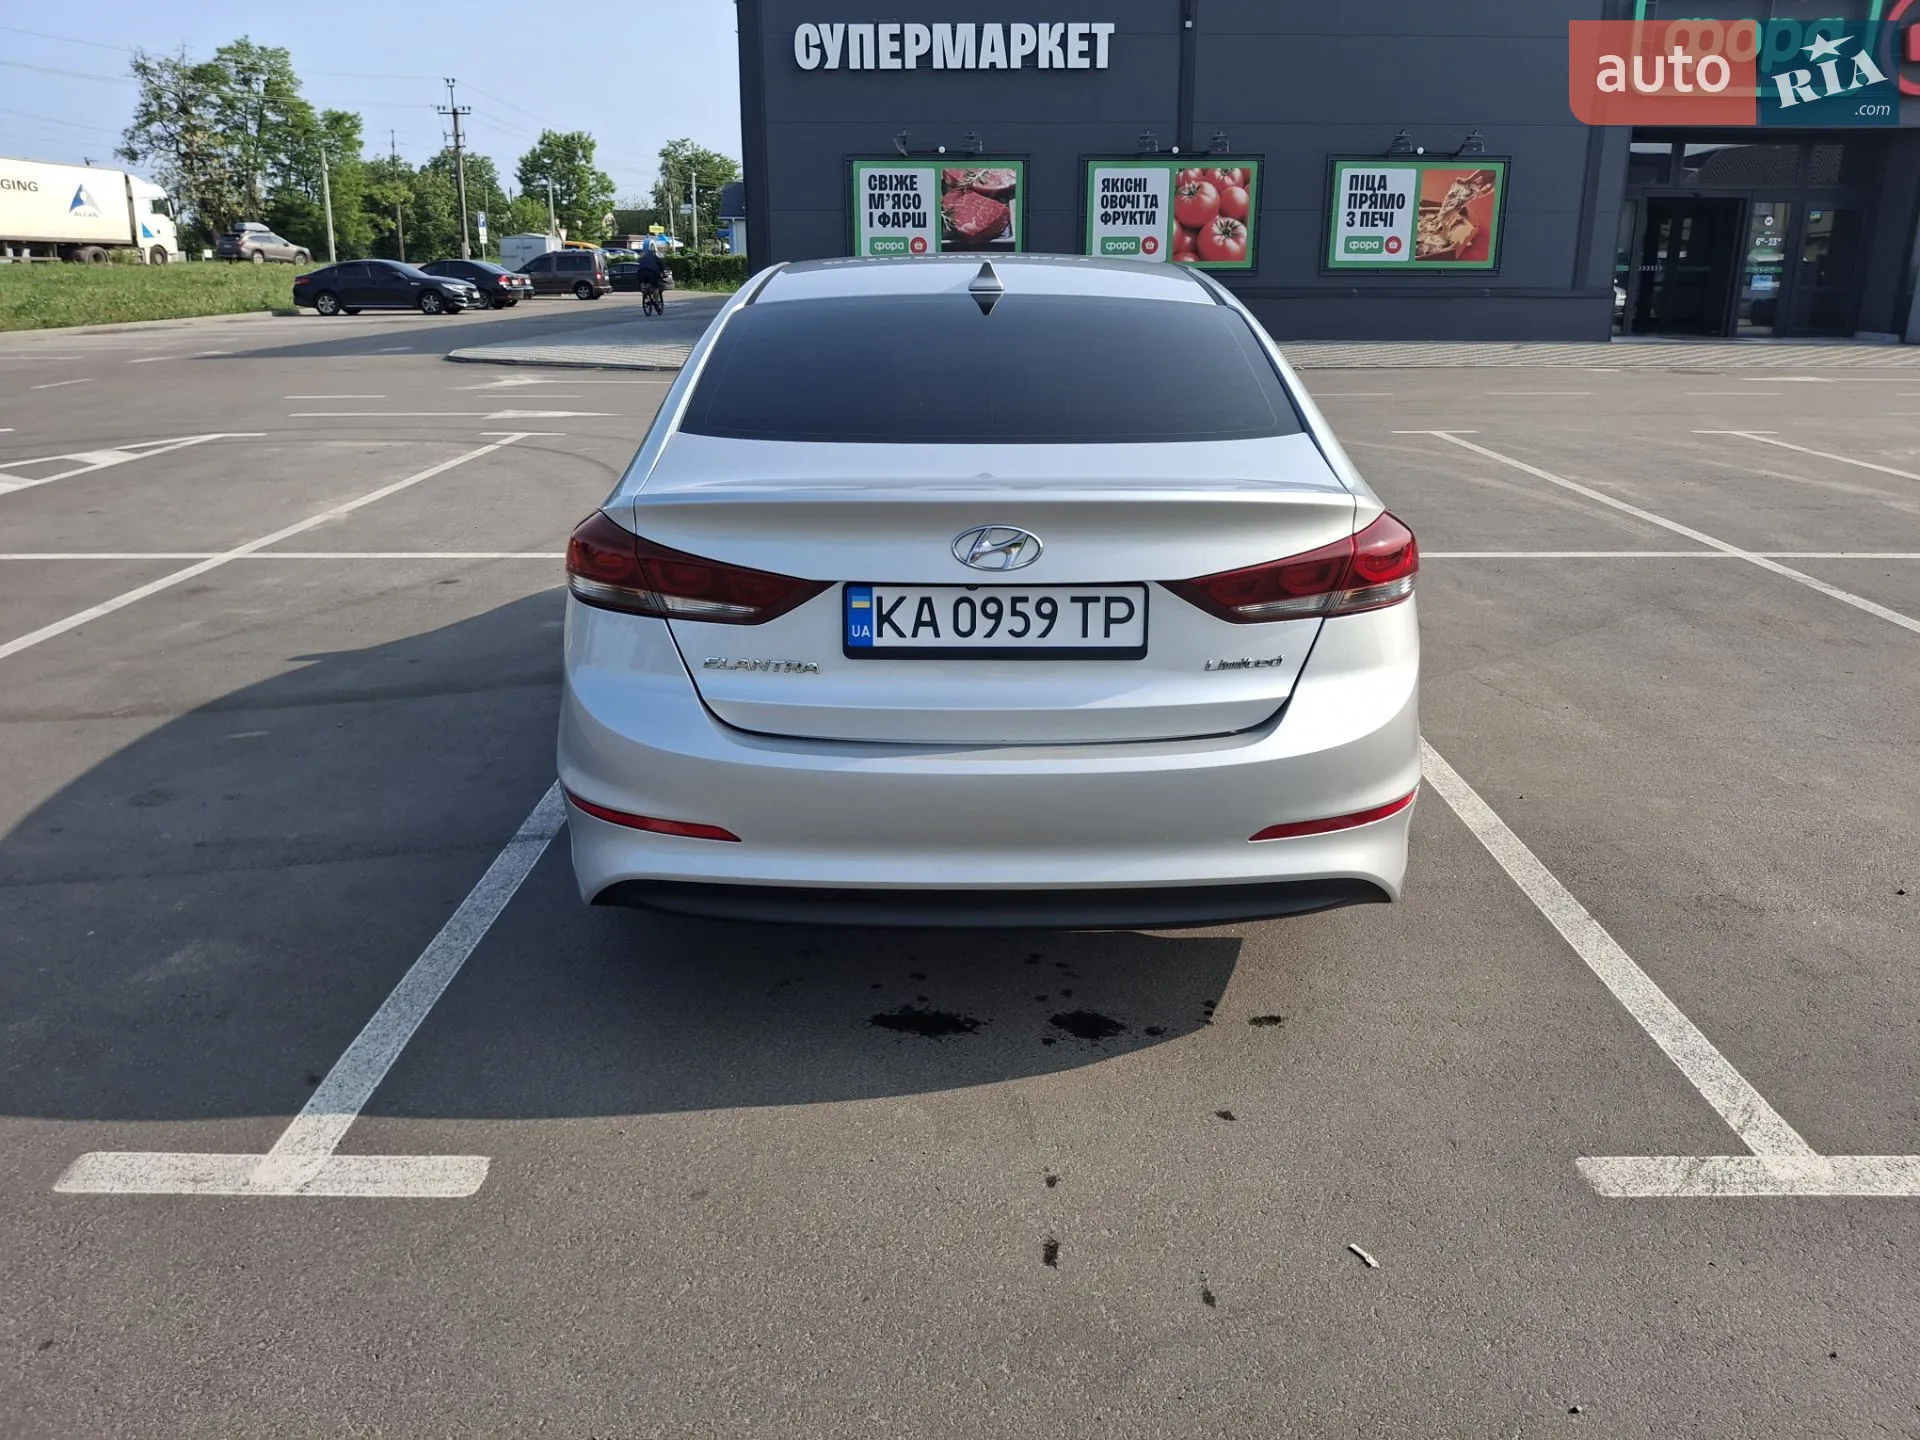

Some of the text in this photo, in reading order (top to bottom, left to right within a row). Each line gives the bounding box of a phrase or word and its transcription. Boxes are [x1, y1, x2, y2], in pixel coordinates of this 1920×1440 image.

[794, 22, 1115, 70] СУПЕРМАРКЕТ
[0, 178, 39, 192] GING
[868, 174, 918, 191] СВІЖЕ
[1101, 177, 1148, 193] ЯКІСНІ
[1349, 174, 1388, 193] ПІЦА
[868, 193, 922, 210] М’ЯСО
[1101, 194, 1159, 209] ОВОЧІ ТА
[1347, 193, 1406, 210] ПРЯМО
[869, 211, 927, 228] І ФАРШ
[1100, 210, 1157, 225] ФРУКТИ
[1346, 211, 1394, 228] З ПЕЧІ
[874, 241, 905, 251] фора
[1105, 240, 1136, 251] фора
[1349, 241, 1380, 250] фора
[876, 596, 1136, 639] KA 0959 TP
[851, 624, 871, 638] UA
[702, 656, 821, 675] ELANTRA
[1204, 655, 1284, 672] Limited
